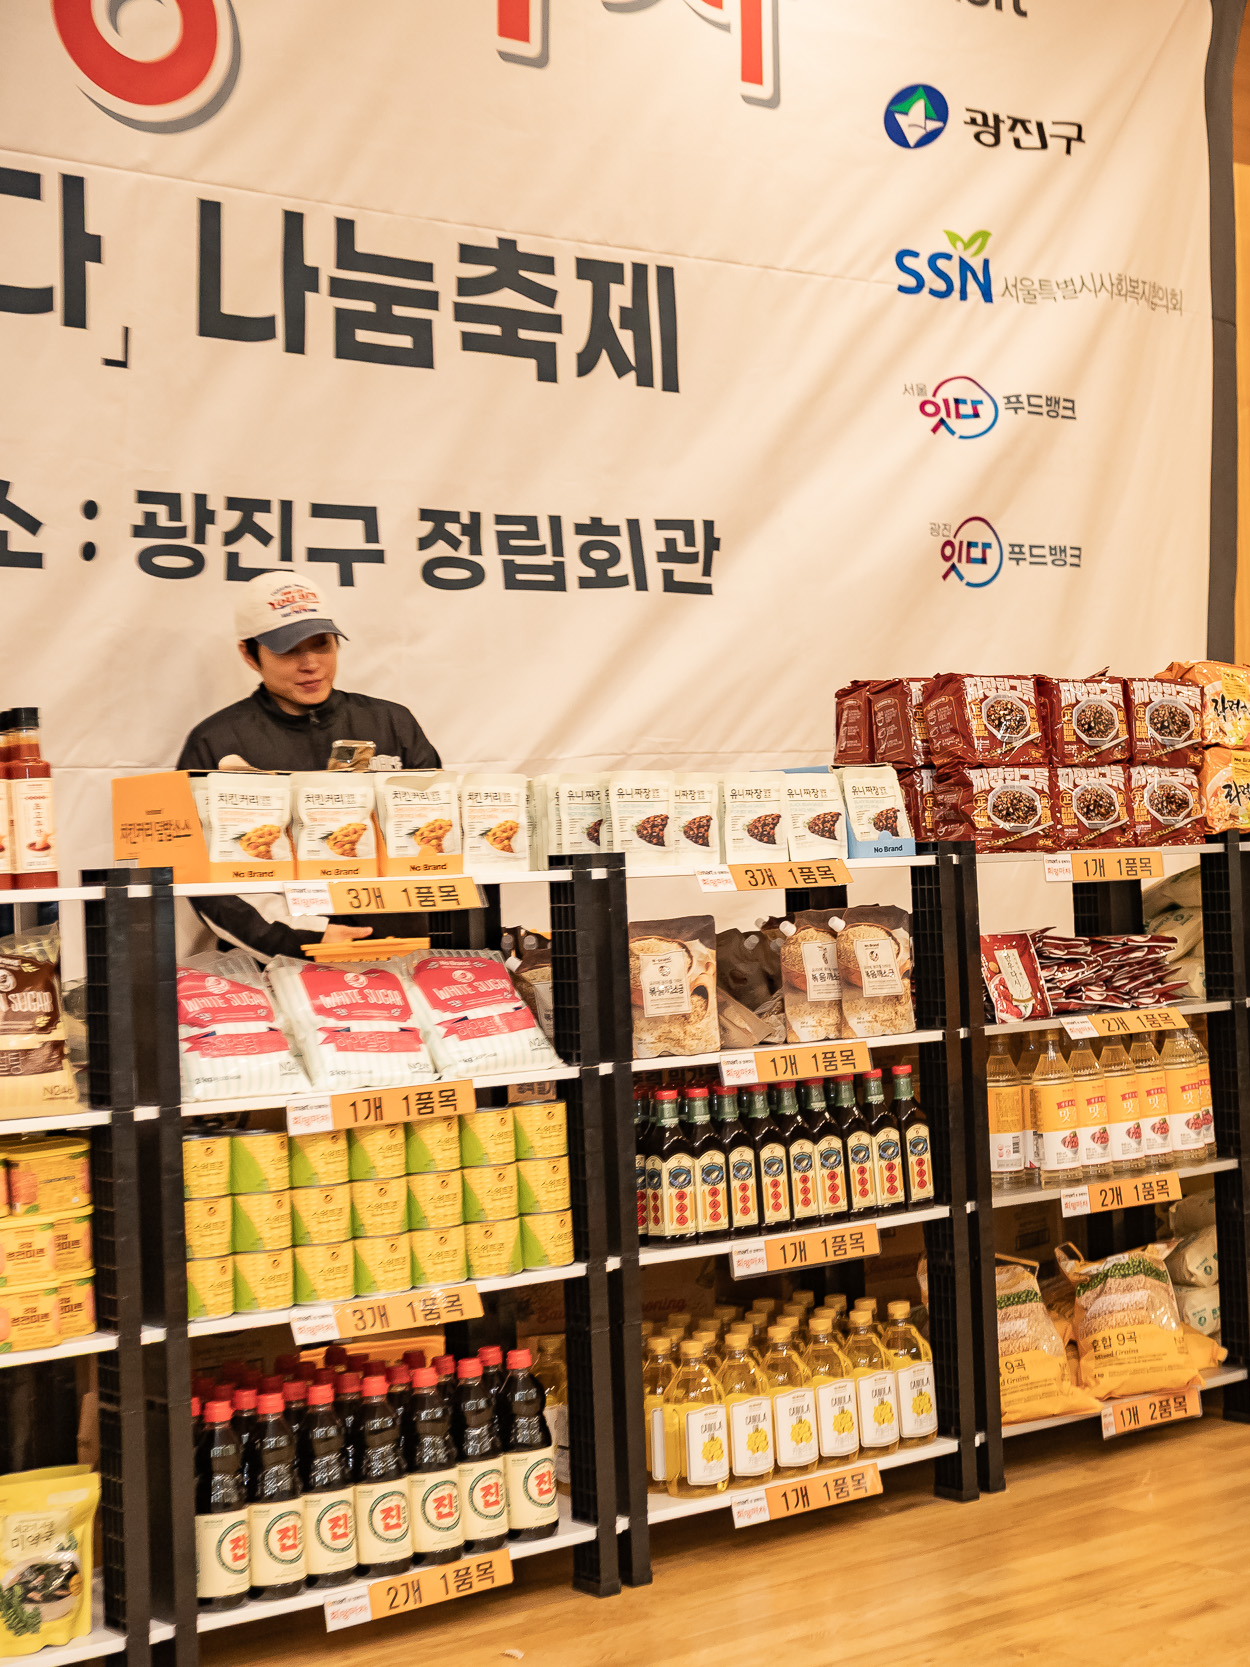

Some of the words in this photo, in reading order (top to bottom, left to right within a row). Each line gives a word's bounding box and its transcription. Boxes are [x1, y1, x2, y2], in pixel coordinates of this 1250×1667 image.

[963, 107, 1085, 155] 광진구
[895, 248, 994, 304] SSN
[196, 198, 680, 393] 나눔축제
[902, 383, 928, 397] 서울
[1002, 393, 1077, 420] 푸드뱅크
[131, 489, 385, 587] 광진구
[417, 508, 721, 595] 정립회관
[1008, 543, 1082, 568] 푸드뱅크
[674, 789, 697, 800] 니짜장
[884, 845, 903, 853] Brand
[334, 868, 359, 876] Brand
[409, 864, 421, 872] No
[423, 863, 448, 871] Brand
[744, 867, 778, 887] 3개
[787, 865, 837, 884] 1품목
[1083, 858, 1106, 878] 1개
[1117, 857, 1152, 876] 1품목
[347, 887, 385, 909] 3개
[401, 884, 461, 907] 1품목
[8, 990, 54, 1013] SUGAR
[319, 989, 365, 1009] WHITE
[364, 989, 405, 1006] SUGAR
[433, 984, 475, 1001] WHITE
[473, 979, 511, 993] SUGAR
[181, 996, 228, 1012] WHITE
[1101, 1016, 1130, 1032] 2개
[1135, 1012, 1173, 1030] 1품목
[769, 1055, 798, 1077] 1개
[811, 1049, 856, 1073] 1품목
[349, 1096, 383, 1122] 1개
[401, 1088, 457, 1117] 1품목
[1100, 1186, 1123, 1207] 2개
[1134, 1179, 1170, 1202] 1품목
[779, 1242, 808, 1265] 1개
[821, 1231, 866, 1258] 1품목
[351, 1306, 390, 1331] 3개
[406, 1294, 465, 1323] 1품목
[1091, 1334, 1112, 1353] 혼합
[1116, 1331, 1137, 1346] 9곡
[1005, 1358, 1026, 1374] 9곡
[1120, 1405, 1140, 1428] 1개
[1149, 1395, 1188, 1421] 2품목
[781, 1488, 810, 1512] 1개
[822, 1472, 868, 1501] 1품목
[386, 1578, 423, 1611] 2개
[440, 1561, 495, 1596] 1품목
